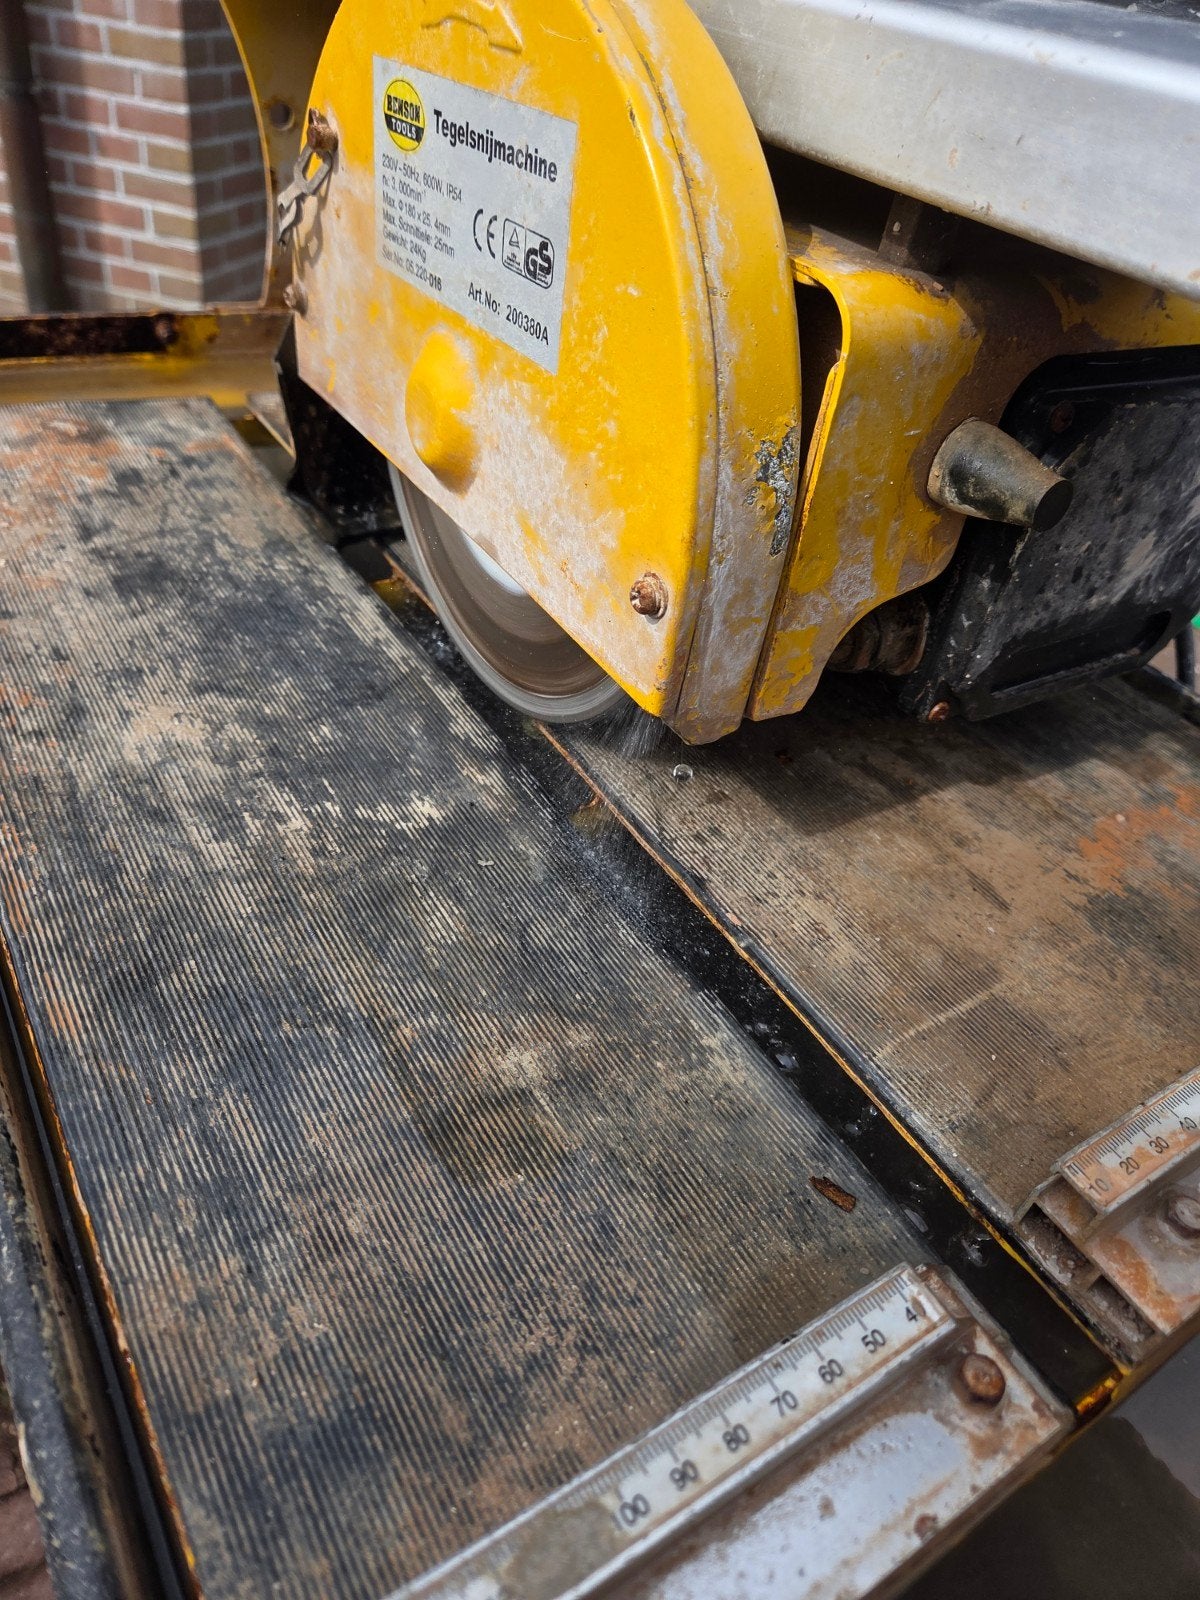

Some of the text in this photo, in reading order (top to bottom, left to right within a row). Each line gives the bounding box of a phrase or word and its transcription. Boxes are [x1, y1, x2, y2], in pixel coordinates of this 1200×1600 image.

[387, 94, 420, 123] BENSON
[391, 118, 417, 139] TOOLS
[434, 109, 557, 182] Tegelsnijmachine
[446, 182, 462, 202] IP54
[434, 236, 455, 260] 25mm
[506, 304, 549, 345] 200380A
[1089, 1178, 1109, 1196] 10
[1119, 1157, 1140, 1175] 20
[1149, 1136, 1169, 1154] 30
[669, 1459, 698, 1491] 90
[722, 1423, 751, 1453] 80
[770, 1390, 798, 1418] 70
[818, 1358, 843, 1384] 60
[861, 1328, 886, 1354] 50
